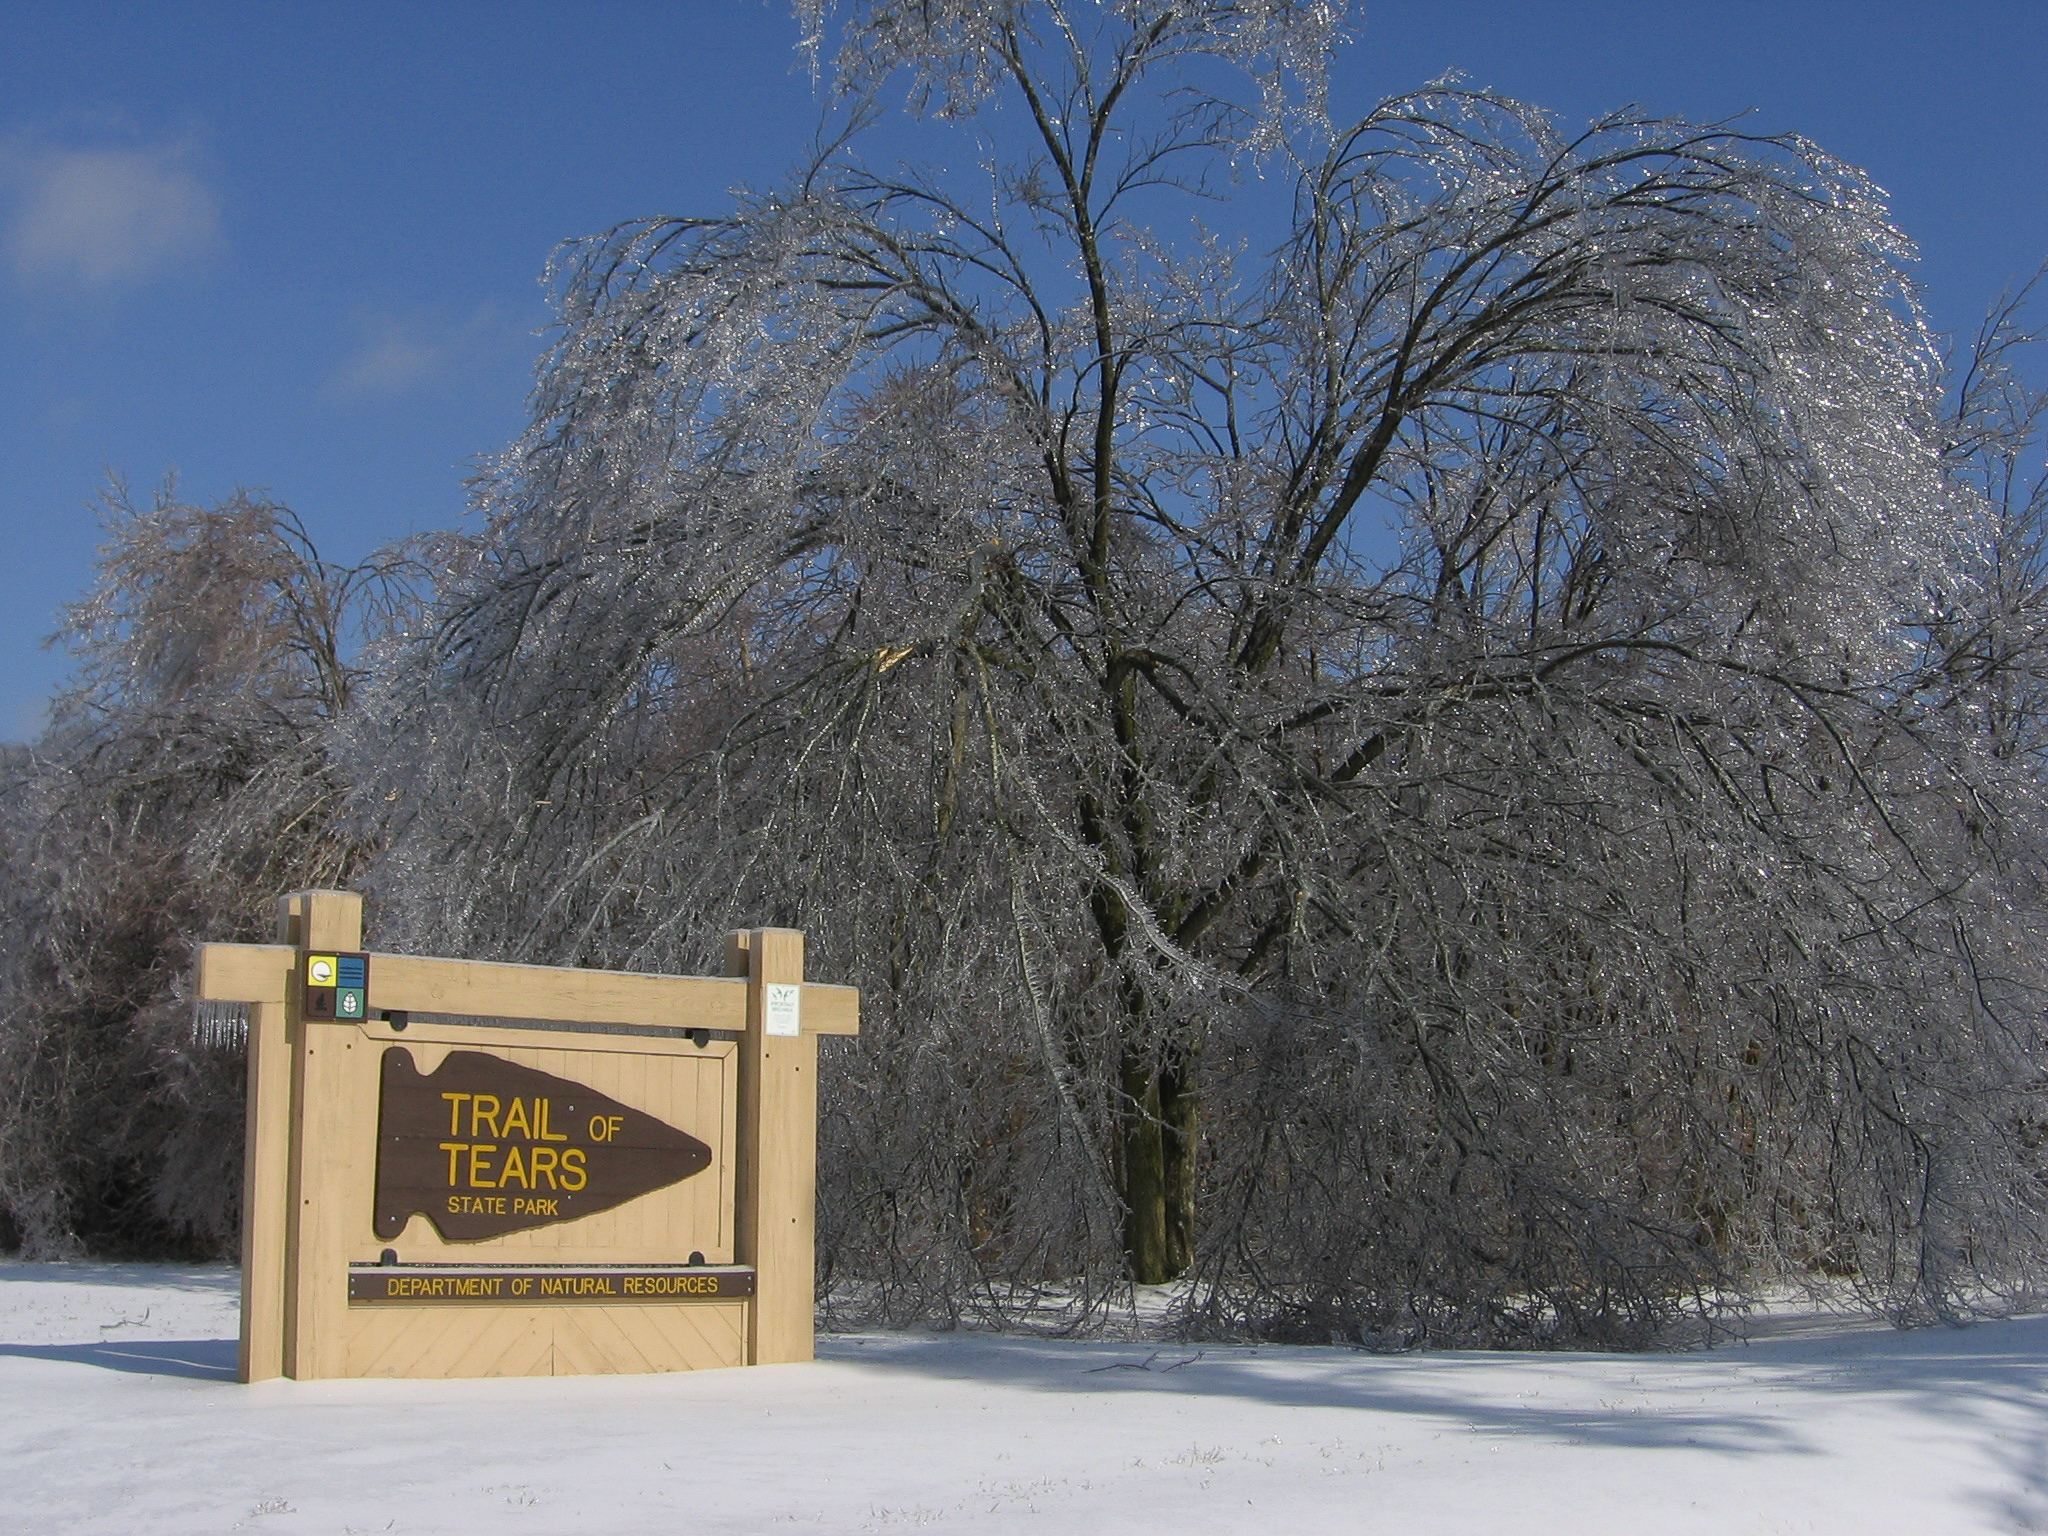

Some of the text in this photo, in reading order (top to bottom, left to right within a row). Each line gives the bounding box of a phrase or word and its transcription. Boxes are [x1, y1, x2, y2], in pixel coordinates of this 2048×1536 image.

[441, 1092, 624, 1142] TRAIL OF
[439, 1142, 587, 1191] TEARS
[448, 1196, 558, 1215] STATE PARK
[387, 1276, 719, 1296] DEPARTMENT OF NATURAL RESOURCES
